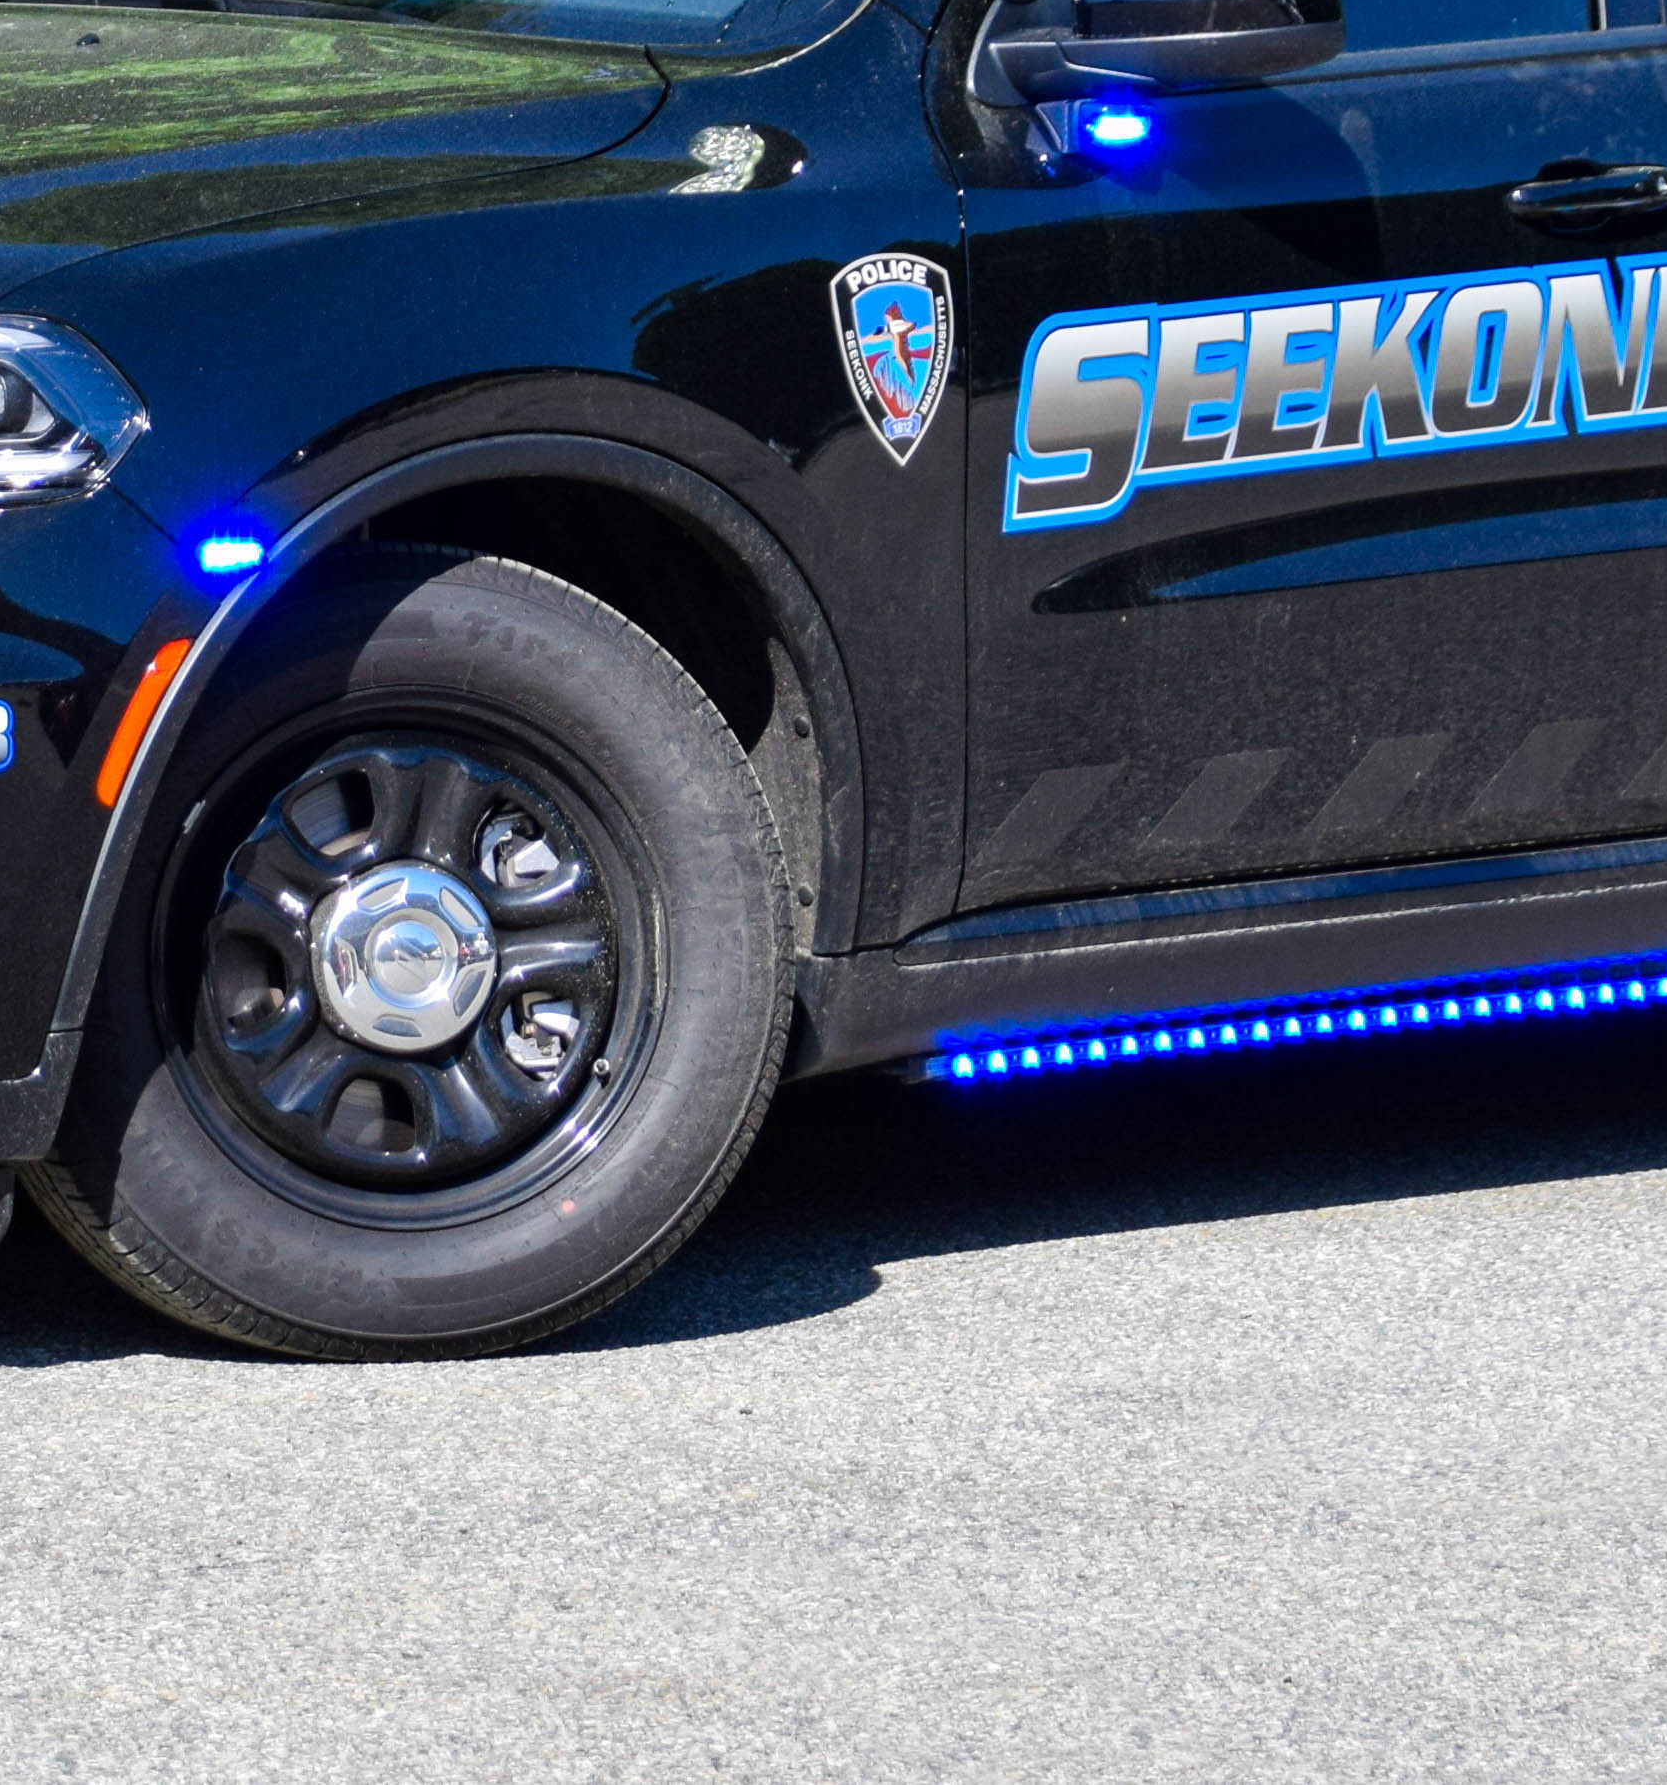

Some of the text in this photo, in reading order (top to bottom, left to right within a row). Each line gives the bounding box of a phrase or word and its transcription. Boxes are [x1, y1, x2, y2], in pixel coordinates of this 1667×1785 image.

[846, 259, 928, 294] POLICE
[845, 329, 875, 402] SEEKONK
[919, 295, 946, 415] MASSACHUSETTS
